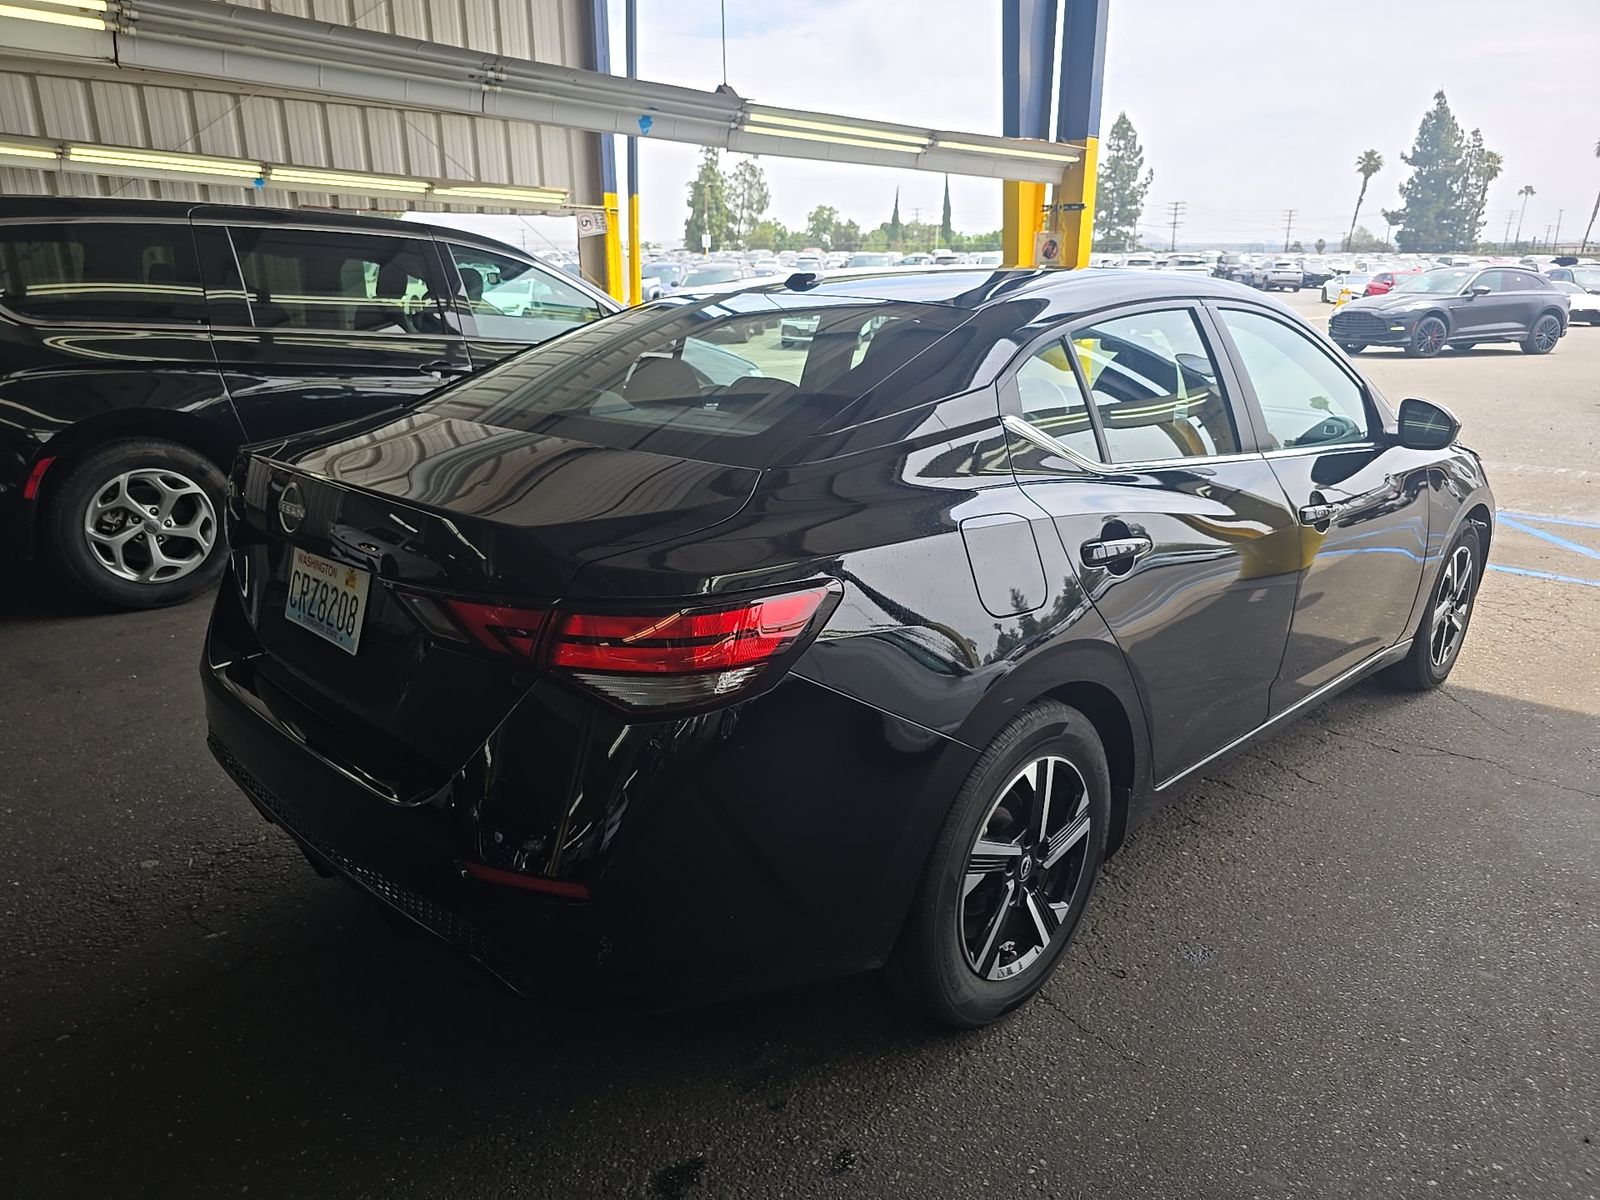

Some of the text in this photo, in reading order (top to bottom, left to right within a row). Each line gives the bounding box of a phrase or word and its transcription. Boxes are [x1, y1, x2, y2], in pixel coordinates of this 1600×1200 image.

[581, 219, 592, 228] 5
[279, 501, 306, 518] SSAN
[298, 552, 337, 578] WASHINGTON
[290, 570, 358, 637] CRZ8208
